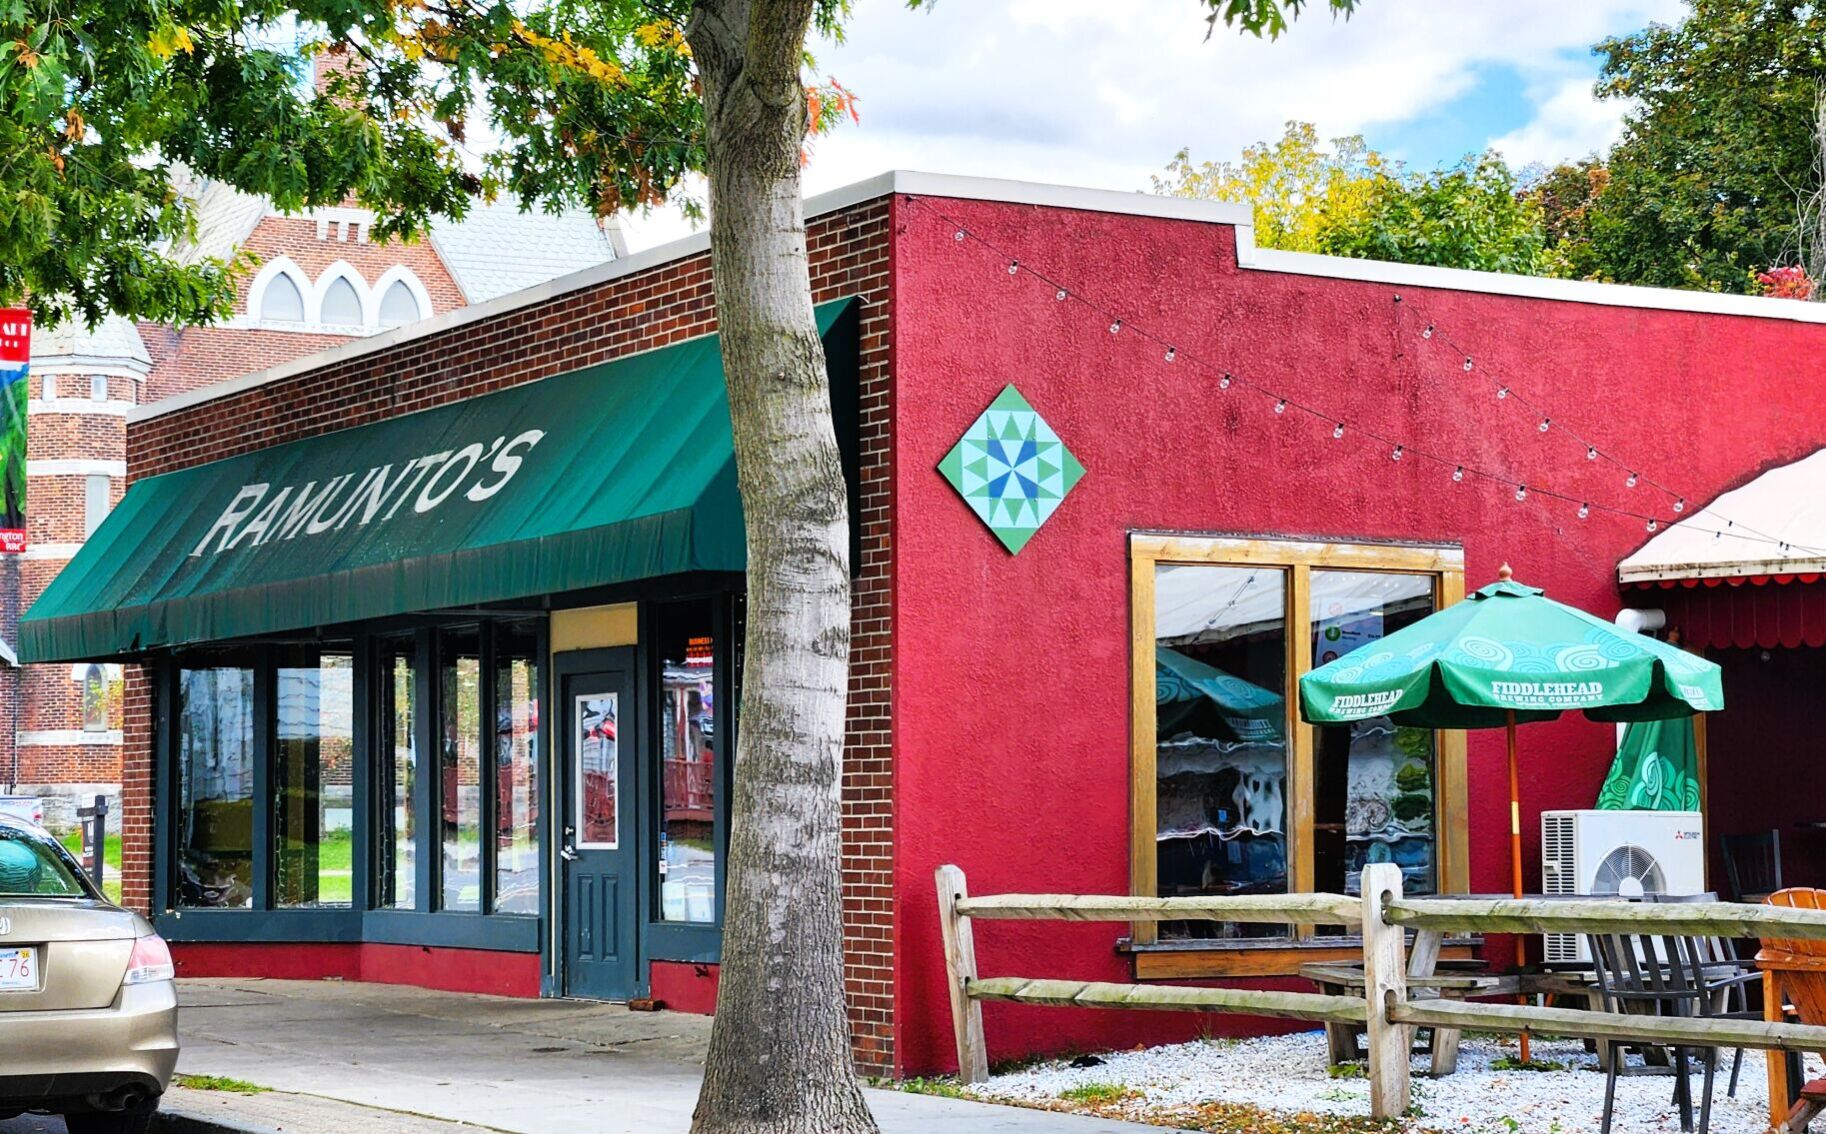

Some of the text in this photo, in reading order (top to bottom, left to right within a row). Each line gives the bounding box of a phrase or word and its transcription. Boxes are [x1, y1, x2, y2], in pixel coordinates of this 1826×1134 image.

[189, 430, 546, 557] RAMUNTO'S
[1491, 681, 1603, 695] FIDDLEHEAD
[1332, 689, 1403, 708] FIDDLEHEAD
[1549, 694, 1604, 703] COMPANY
